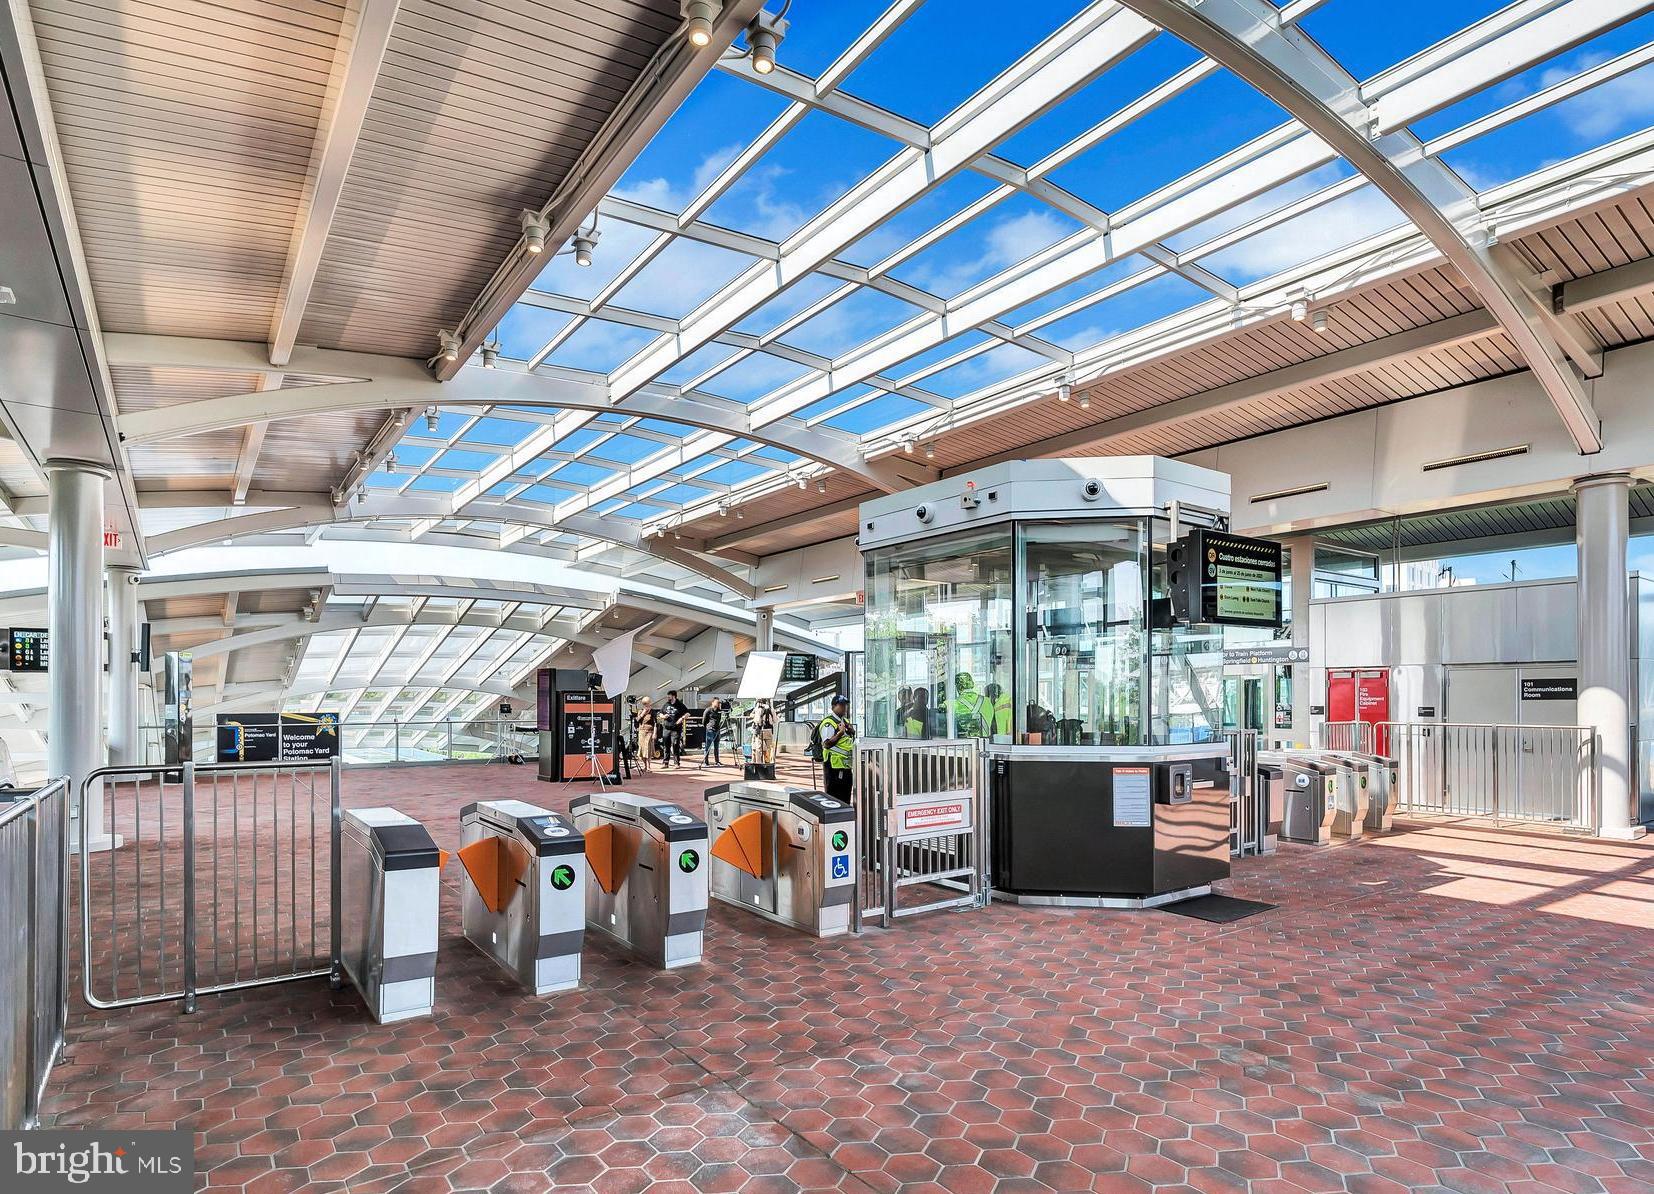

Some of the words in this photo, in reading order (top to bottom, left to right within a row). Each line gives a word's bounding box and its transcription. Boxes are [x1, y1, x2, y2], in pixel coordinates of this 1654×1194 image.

[104, 532, 118, 546] XIT
[1218, 552, 1234, 562] Cuatro
[908, 809, 936, 817] EMERGENCY
